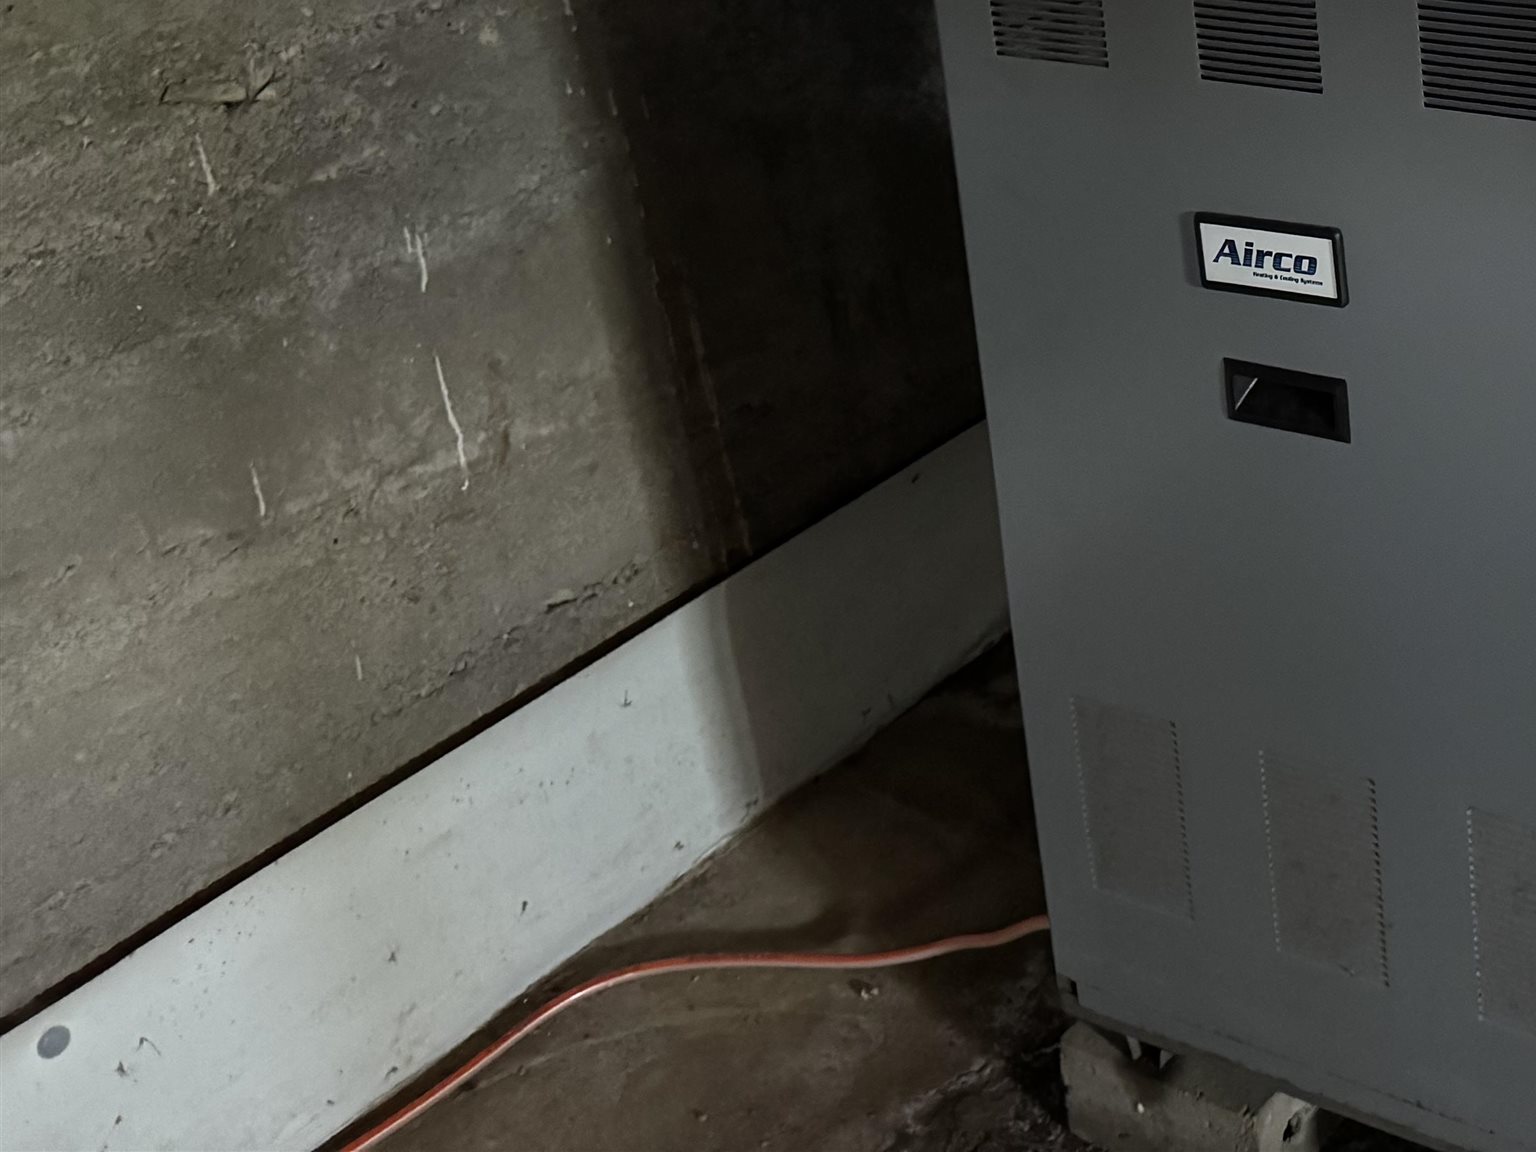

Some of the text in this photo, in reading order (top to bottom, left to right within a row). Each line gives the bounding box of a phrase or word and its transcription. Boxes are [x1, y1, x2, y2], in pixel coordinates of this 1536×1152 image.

[1212, 238, 1317, 276] Airco
[1253, 271, 1273, 280] Heating
[1280, 275, 1299, 283] Cooling
[1300, 278, 1323, 286] Systems
